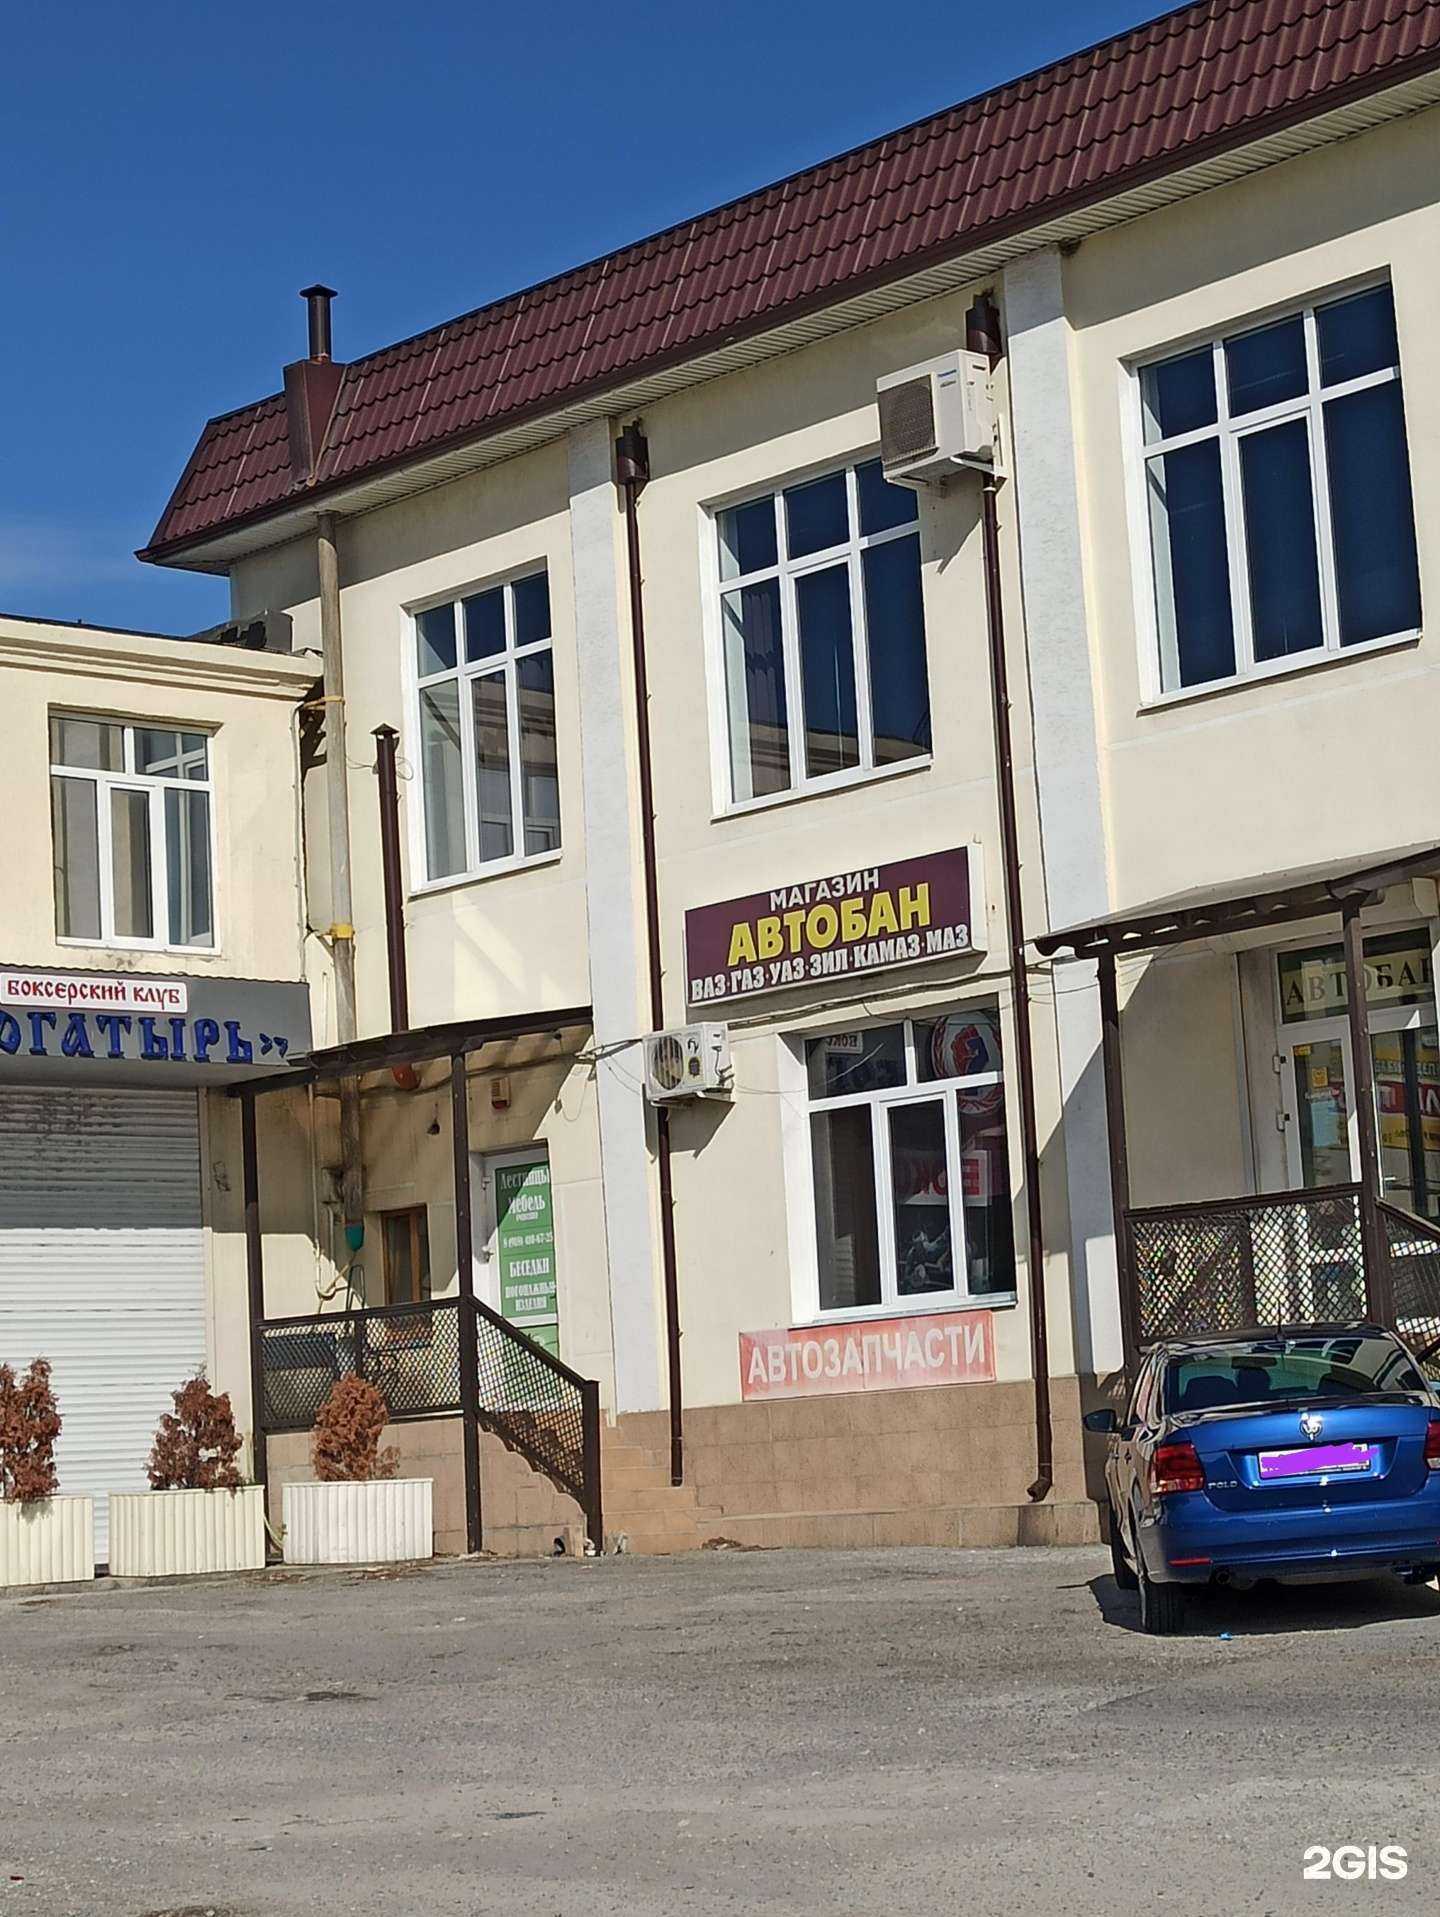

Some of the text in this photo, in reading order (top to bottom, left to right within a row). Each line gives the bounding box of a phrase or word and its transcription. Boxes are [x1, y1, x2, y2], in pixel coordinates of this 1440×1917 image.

[770, 868, 880, 912] МАГАЗИН
[727, 882, 931, 967] АВТОБАН
[691, 923, 969, 1001] ВАЗ ГАЗ УАЗ ЗИЛ КАМАЗ МАЗ
[132, 986, 181, 1010] КЛУБ
[748, 1323, 986, 1384] АВТОЗАПЧАСТИ
